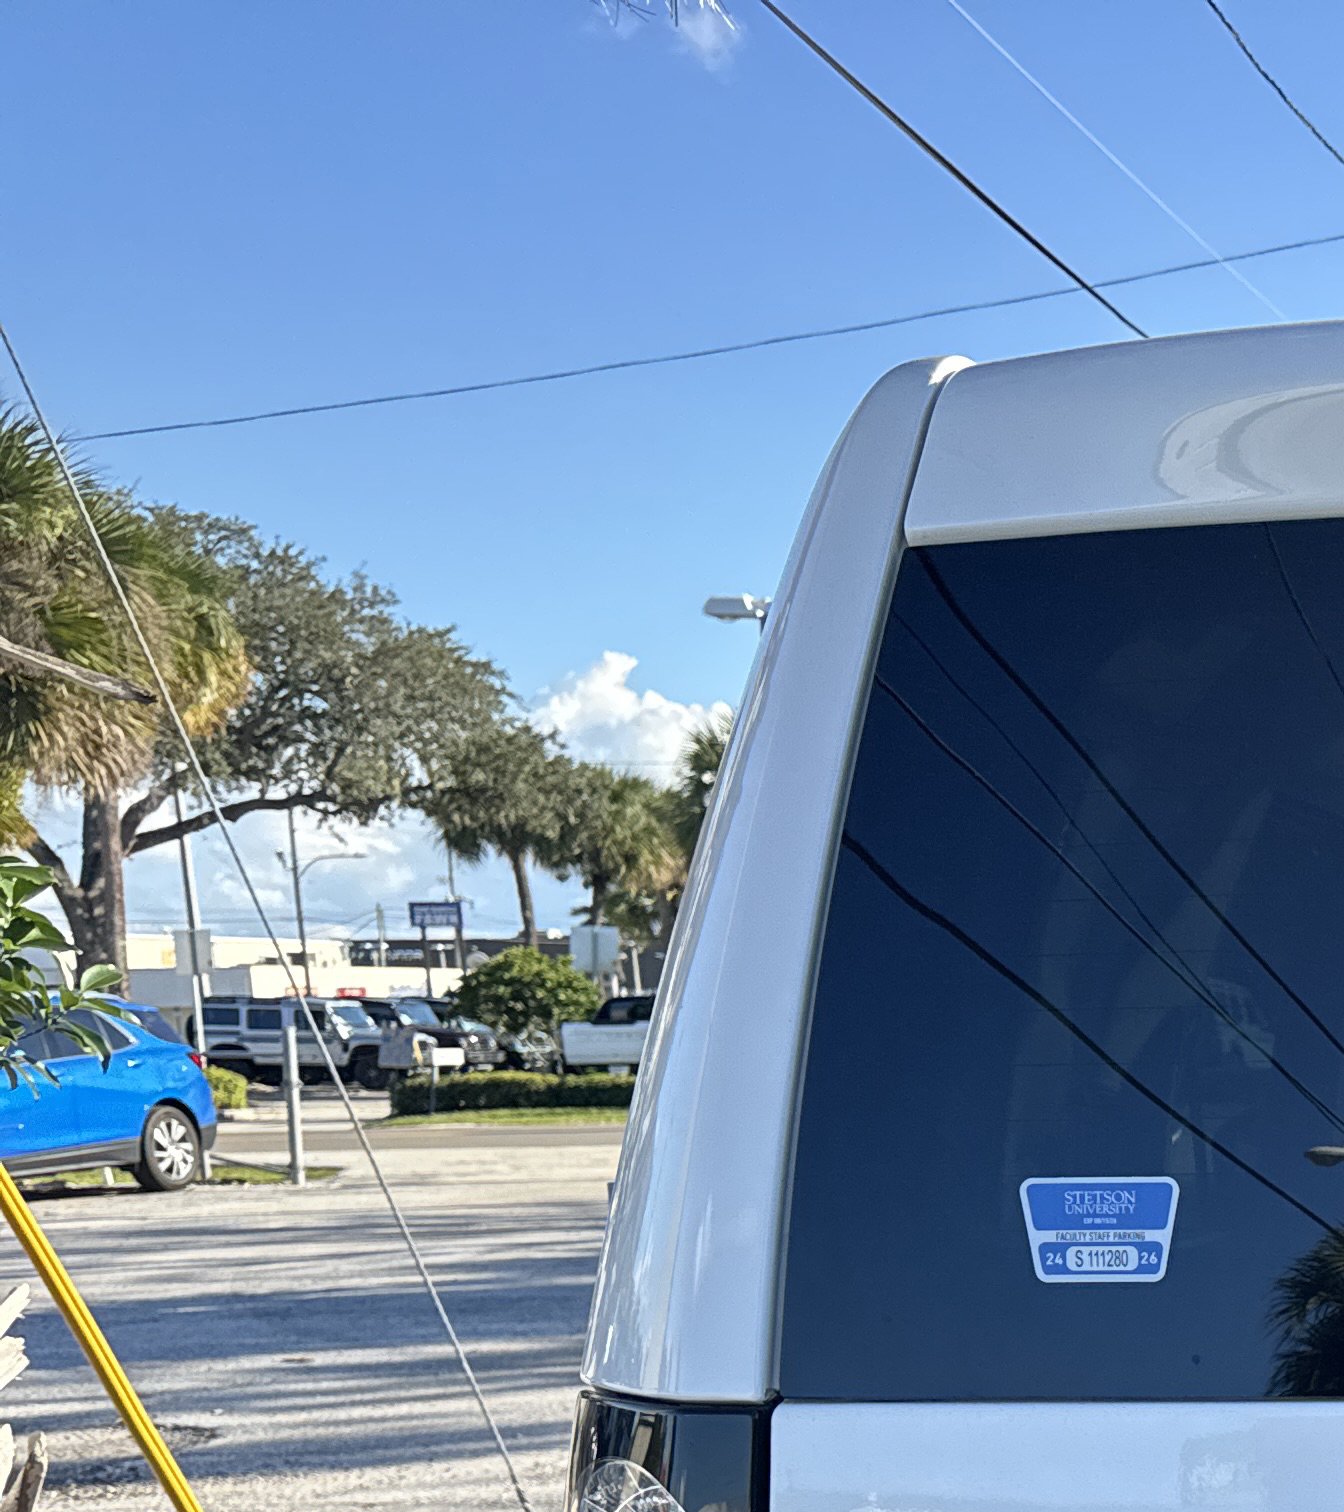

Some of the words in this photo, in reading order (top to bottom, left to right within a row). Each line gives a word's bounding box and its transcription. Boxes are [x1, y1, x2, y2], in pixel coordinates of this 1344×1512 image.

[1064, 1190, 1136, 1205] STETSON
[1065, 1204, 1136, 1215] UNIVERSITY
[1055, 1231, 1087, 1242] FACULTY
[1088, 1231, 1111, 1241] STAFF
[1113, 1231, 1146, 1242] PARKING
[1045, 1253, 1064, 1265] 24
[1075, 1250, 1084, 1267] S
[1087, 1249, 1129, 1267] 111280
[1140, 1252, 1158, 1265] 26
